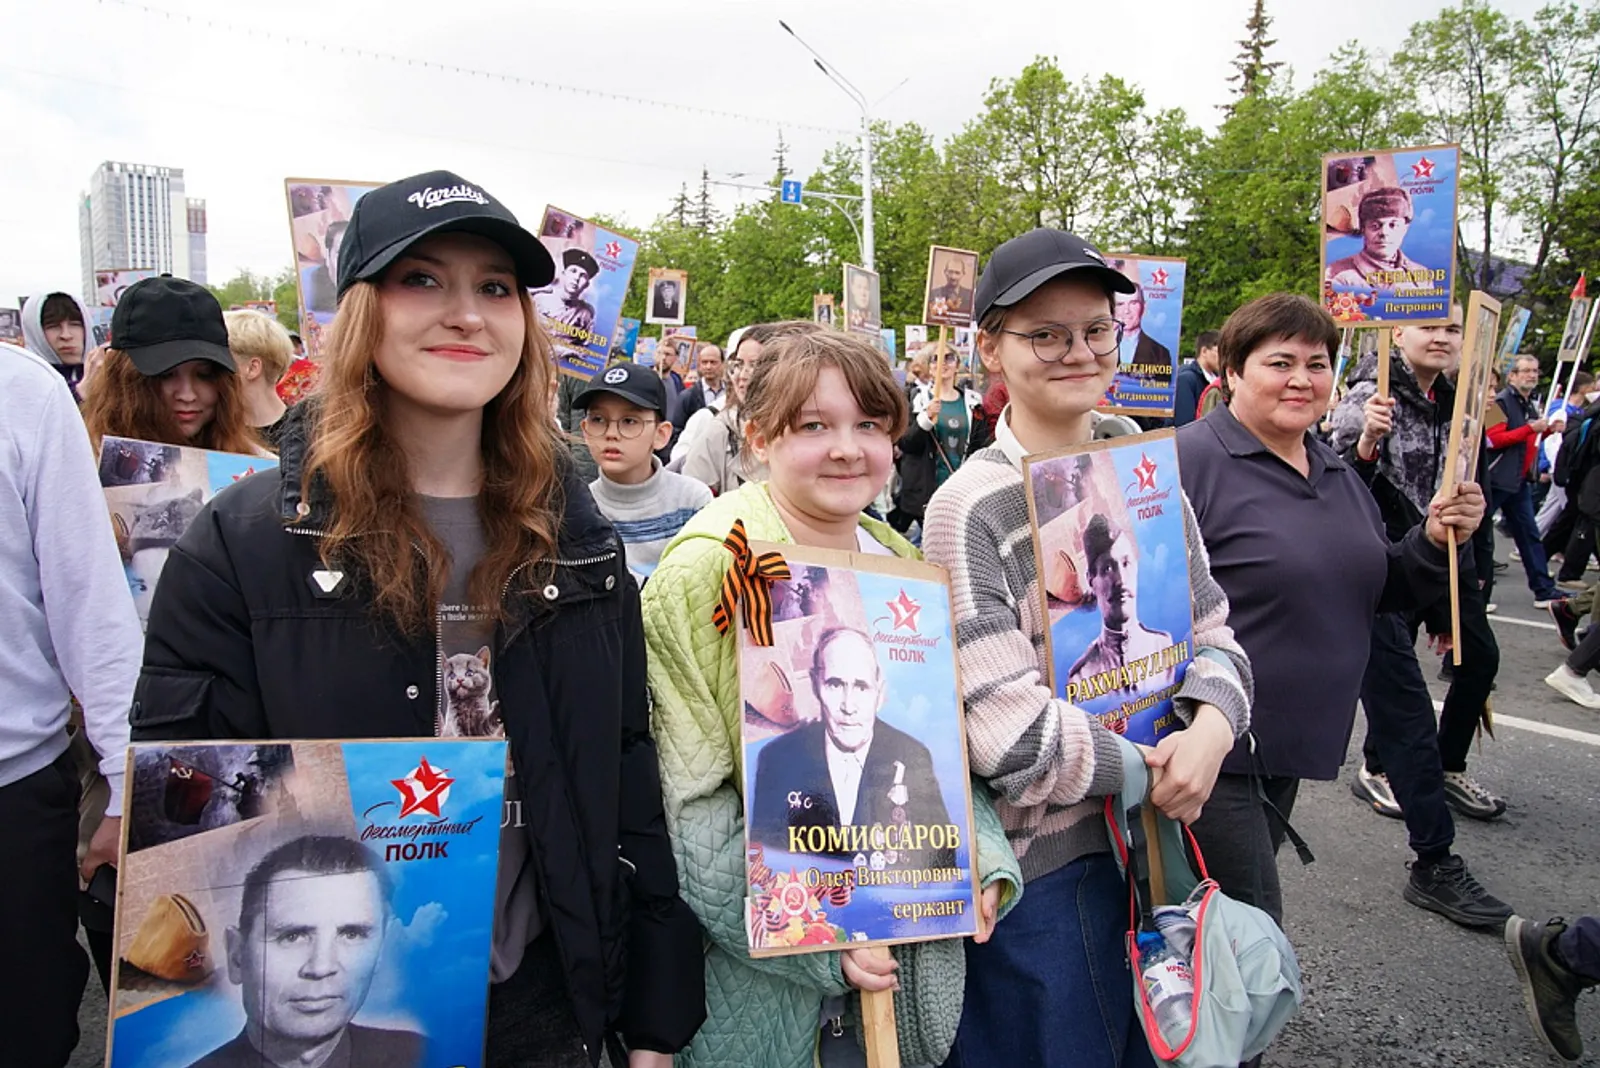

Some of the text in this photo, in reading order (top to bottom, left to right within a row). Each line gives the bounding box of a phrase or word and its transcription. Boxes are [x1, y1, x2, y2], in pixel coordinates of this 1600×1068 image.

[1366, 269, 1446, 285] СТЕПАНОВ
[1385, 301, 1444, 315] Петрович
[1113, 391, 1170, 403] Ситдикович
[1137, 504, 1164, 521] ПОЛК
[873, 616, 941, 649] бессмертный
[889, 647, 926, 664] ПОЛК
[1066, 640, 1189, 705] РАХМАТУЛЛИН
[361, 801, 483, 841] бессмертный
[787, 824, 961, 853] КОМИССАРОВ
[385, 841, 449, 862] ПОЛК
[806, 865, 963, 889] Олег Викторович
[893, 899, 966, 923] сержант
